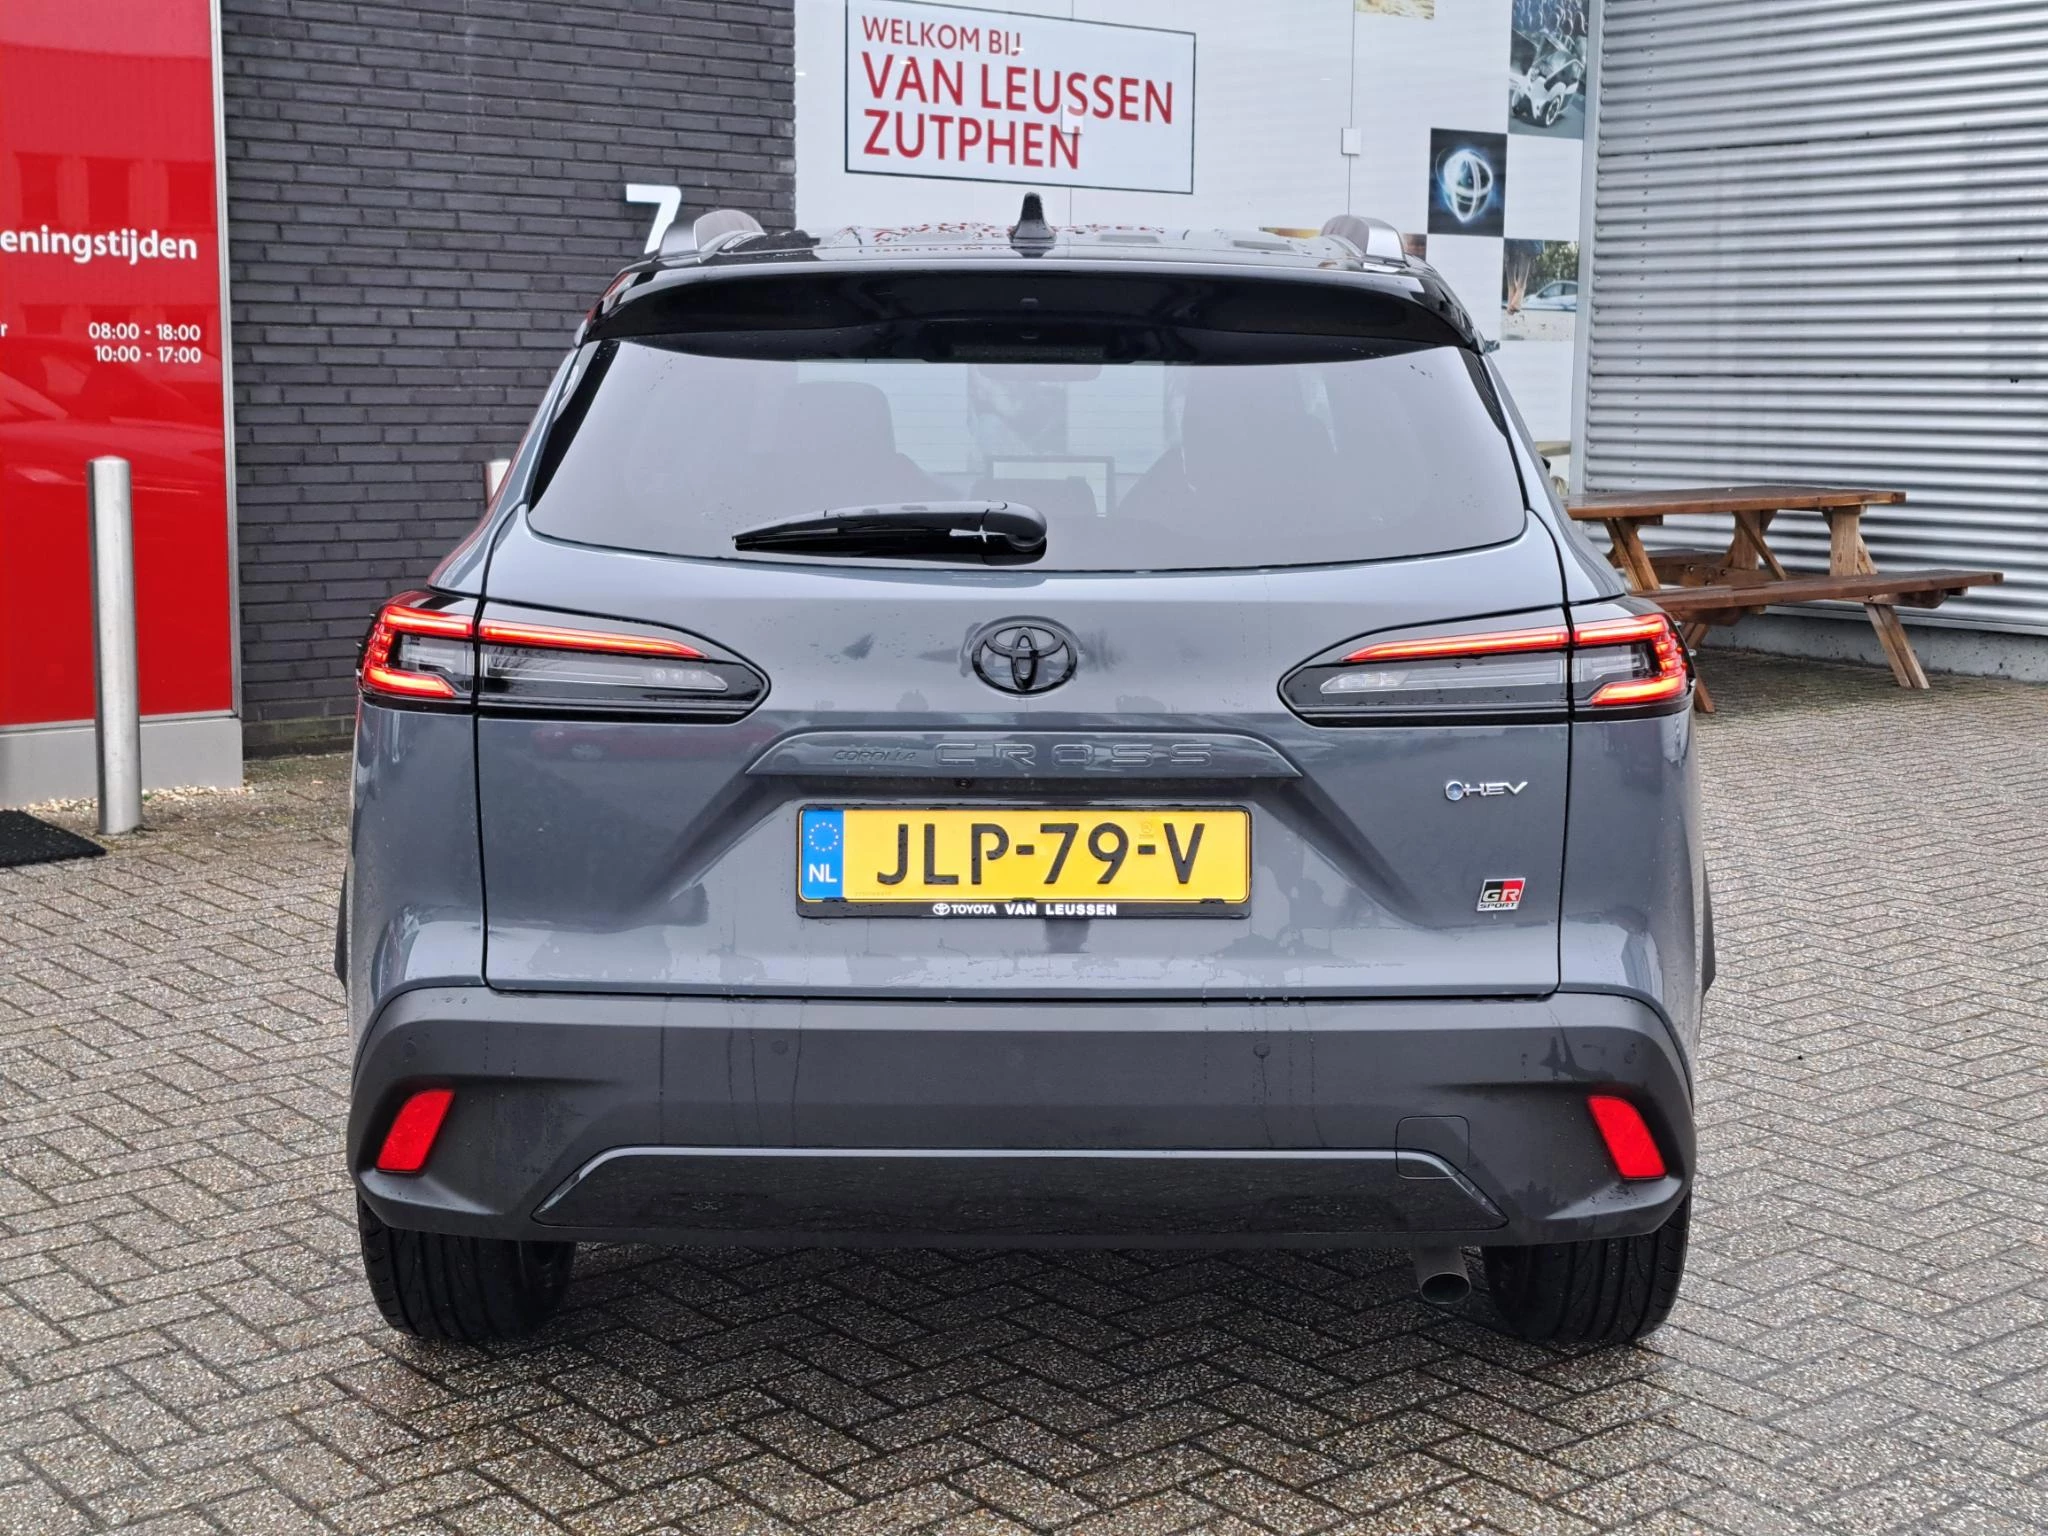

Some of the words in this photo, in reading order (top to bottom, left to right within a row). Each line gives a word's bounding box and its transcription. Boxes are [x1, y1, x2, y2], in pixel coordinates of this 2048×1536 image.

[861, 15, 980, 51] WELKOM
[988, 29, 1021, 56] BIJ
[861, 51, 963, 106] VAN
[981, 62, 1173, 125] LEUSSEN
[863, 108, 1080, 170] ZUTPHEN
[626, 183, 682, 254] 7
[0, 224, 198, 265] eningstijden
[88, 322, 140, 339] 08:00
[156, 324, 201, 341] 18:00
[94, 345, 141, 362] 10:00
[157, 346, 201, 363] 17:00
[832, 748, 918, 762] COROLLA
[935, 743, 1212, 768] CROSS
[876, 822, 1206, 886] JLP-79-V
[808, 863, 838, 883] NL
[951, 904, 997, 915] TOYOTA
[1004, 903, 1037, 916] VAN
[1045, 903, 1117, 916] LEUSSEN
[1482, 888, 1521, 903] GR
